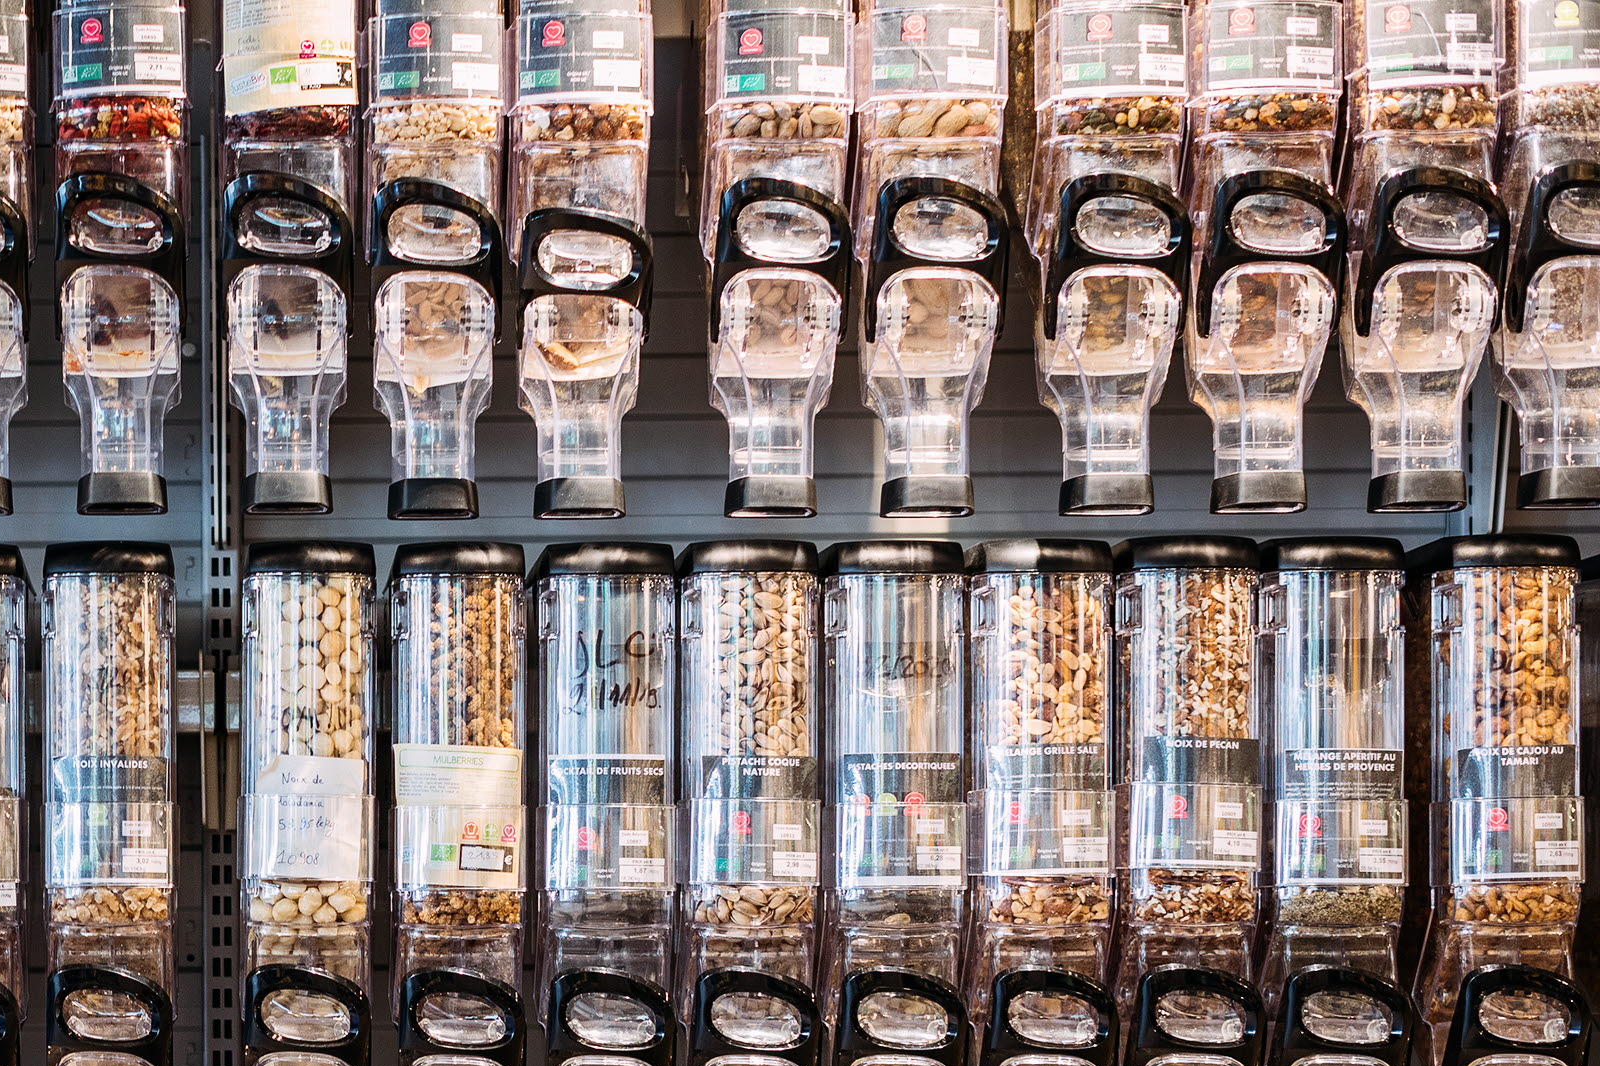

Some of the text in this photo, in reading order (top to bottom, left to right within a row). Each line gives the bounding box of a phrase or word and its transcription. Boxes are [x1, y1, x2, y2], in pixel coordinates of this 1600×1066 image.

[1195, 740, 1207, 749] DE
[1209, 740, 1240, 750] PECAN
[1045, 747, 1076, 756] GRILLE
[1078, 746, 1099, 755] SALE
[1501, 747, 1515, 755] DE
[1517, 747, 1549, 755] CAJOU
[1551, 746, 1564, 755] AU
[432, 754, 484, 766] MULBERRIES
[1343, 752, 1382, 761] APERITIF
[1383, 753, 1396, 761] AU
[1500, 757, 1539, 766] TAMARI
[100, 760, 149, 769] INVALIDES
[722, 757, 801, 767] PISTACHE COQUE
[848, 762, 956, 771] PISTACHES DECORTIQUEES
[1295, 762, 1395, 772] HERBES DE PROVENCE
[597, 766, 608, 775] DE
[611, 766, 641, 776] FRUITS
[643, 766, 664, 776] SECS
[743, 767, 781, 777] NATURE
[281, 772, 325, 785] Noix de
